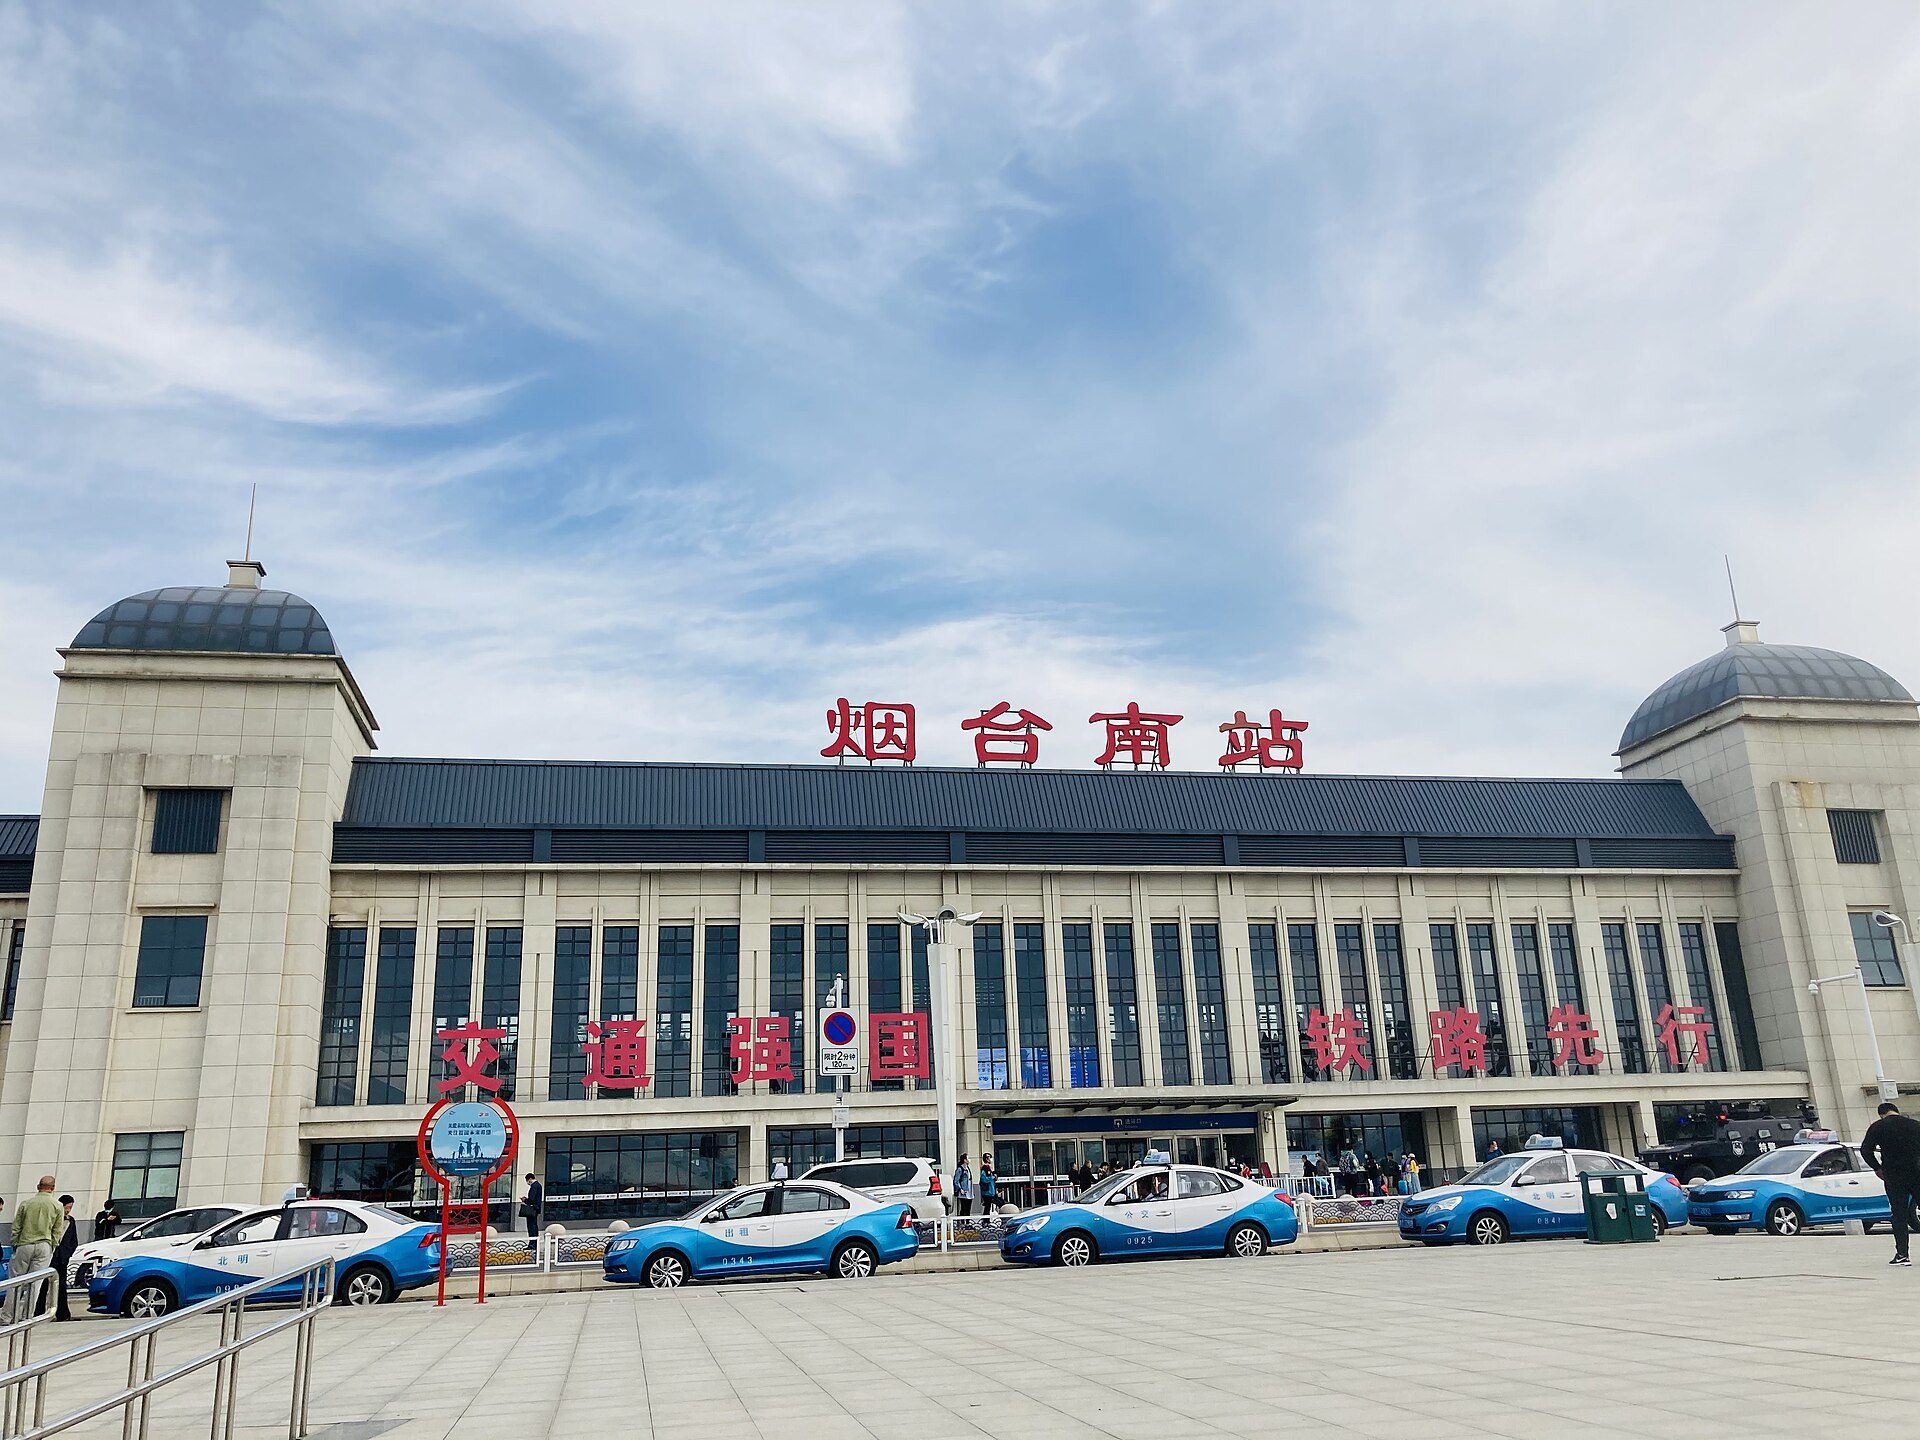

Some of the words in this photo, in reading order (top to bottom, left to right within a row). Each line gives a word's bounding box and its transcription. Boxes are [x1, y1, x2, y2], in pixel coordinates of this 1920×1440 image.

[820, 697, 1309, 768] 烟台南站
[437, 1012, 929, 1092] 交通强国
[1307, 1003, 1713, 1072] 铁路先行
[824, 1051, 856, 1061] 限时2分钟
[725, 1227, 749, 1237] 出租
[1127, 1236, 1153, 1245] 0925
[217, 1254, 249, 1266] 北明
[722, 1256, 753, 1265] 0343
